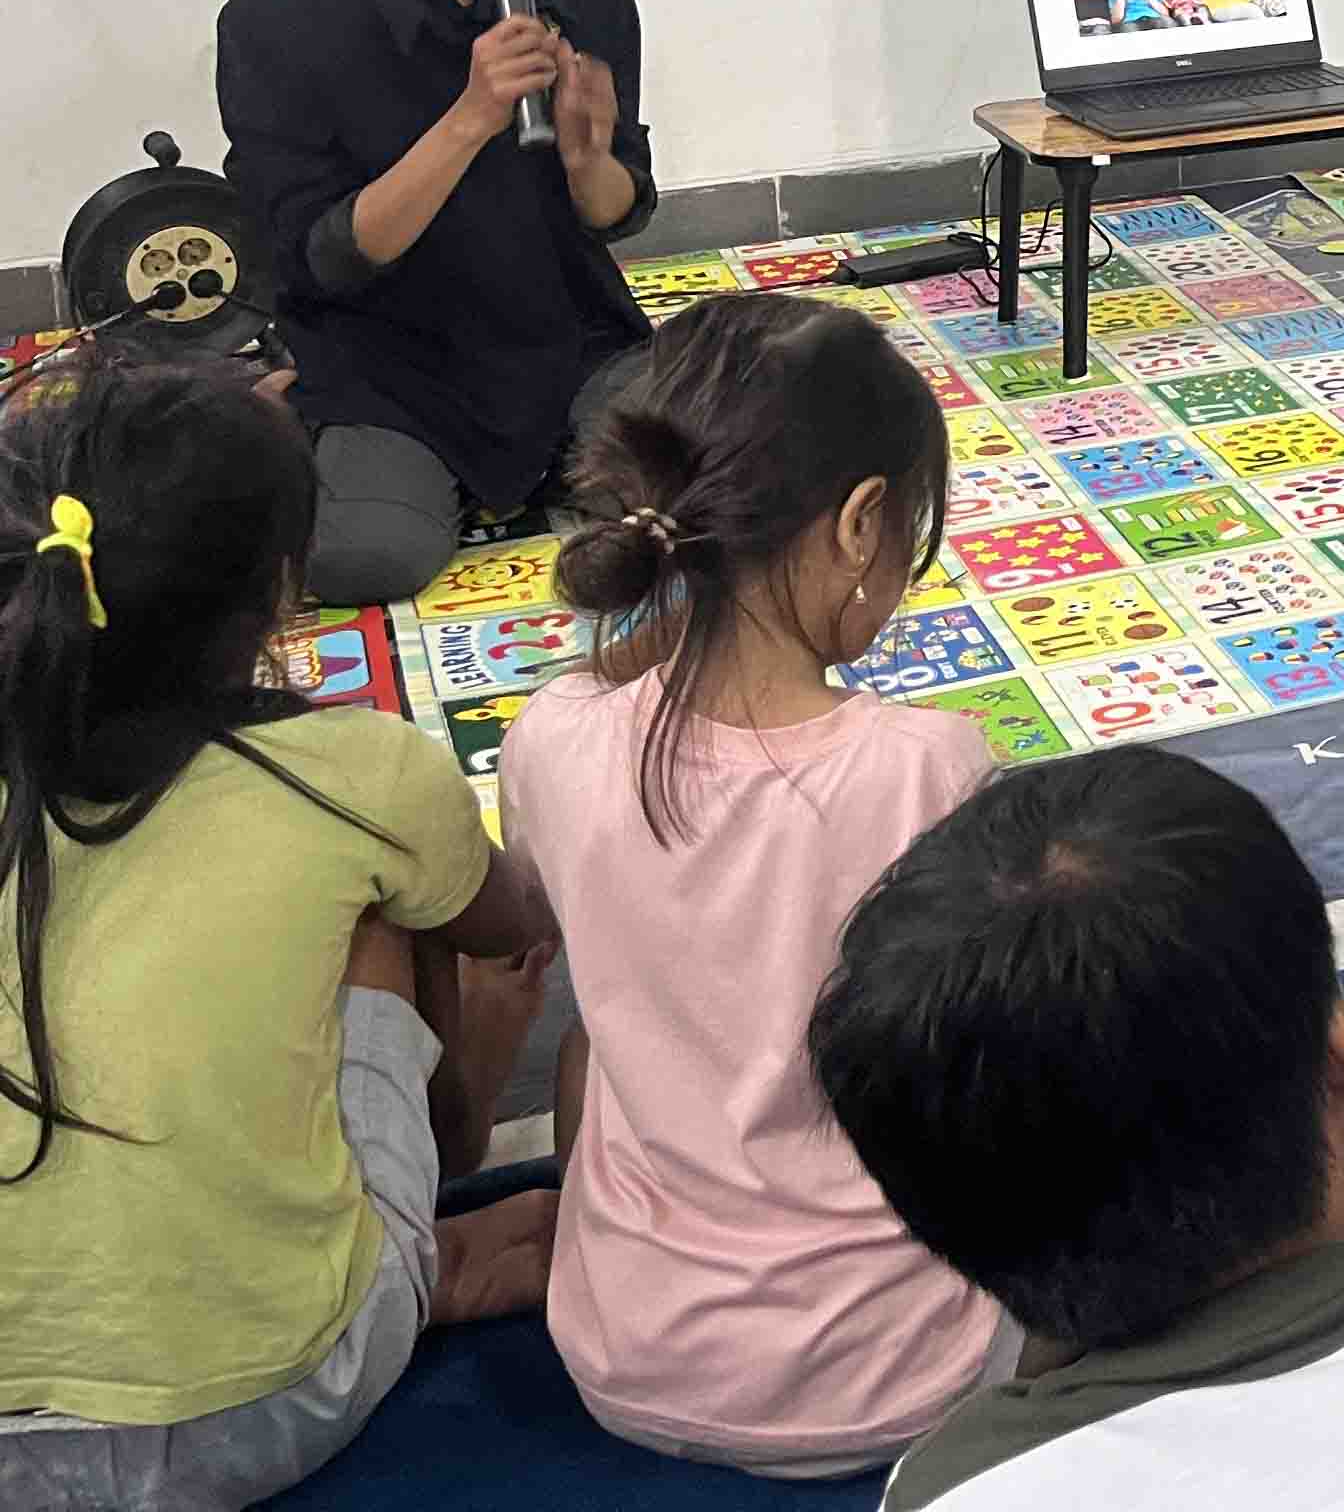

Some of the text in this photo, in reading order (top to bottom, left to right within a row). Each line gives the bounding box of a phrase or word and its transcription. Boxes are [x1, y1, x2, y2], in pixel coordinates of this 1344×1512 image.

[1040, 423, 1100, 446] 14
[1235, 448, 1293, 474] 16
[1142, 529, 1206, 559] 12
[1200, 595, 1265, 626] 14
[438, 624, 495, 689] LEARNING
[1090, 700, 1155, 739] 10
